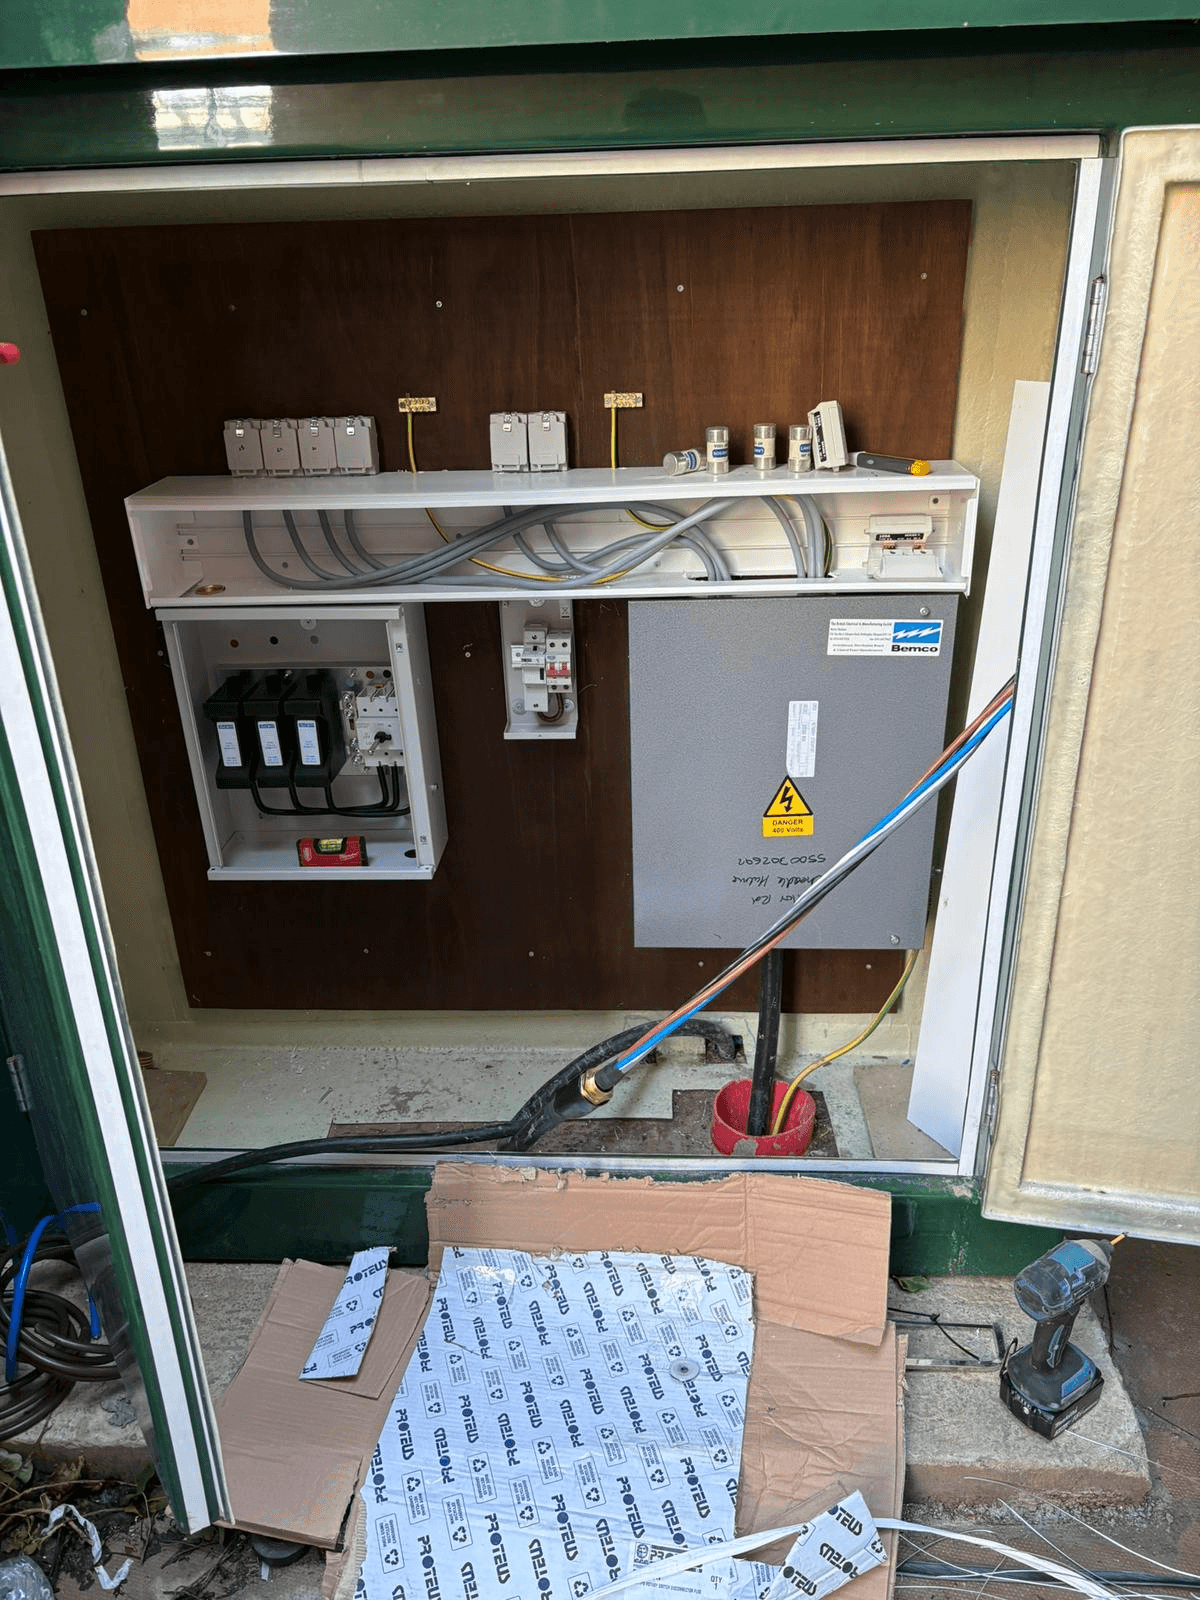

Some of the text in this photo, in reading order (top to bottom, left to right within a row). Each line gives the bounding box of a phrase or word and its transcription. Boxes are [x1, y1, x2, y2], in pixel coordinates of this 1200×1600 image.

[492, 1282, 512, 1329] PROTEUS
[545, 1264, 570, 1314] PROTEUS
[583, 1282, 608, 1333] PROTEUS
[636, 1262, 664, 1315] PROTEUS
[437, 1298, 456, 1341] PROTEUS
[473, 1317, 492, 1359] PROTEUS
[529, 1300, 550, 1346] PROTEUS
[638, 1353, 665, 1400] PROTEUS
[695, 1334, 723, 1382] PROTEUS
[520, 1381, 543, 1428] PROTEUS
[580, 1368, 605, 1415] PROTEUS
[620, 1386, 647, 1434] PROTEUS
[395, 1409, 414, 1461] PROTEUS
[458, 1395, 479, 1443] PROTEUS
[497, 1413, 520, 1466] PROTEUS
[560, 1399, 584, 1448] PROTEUS
[434, 1427, 455, 1484] PROTEUS
[616, 1476, 645, 1538] PROTEUS
[680, 1457, 710, 1518] PROTEUS
[485, 1513, 510, 1584] PROTEUS
[552, 1494, 578, 1560] PROTEUS
